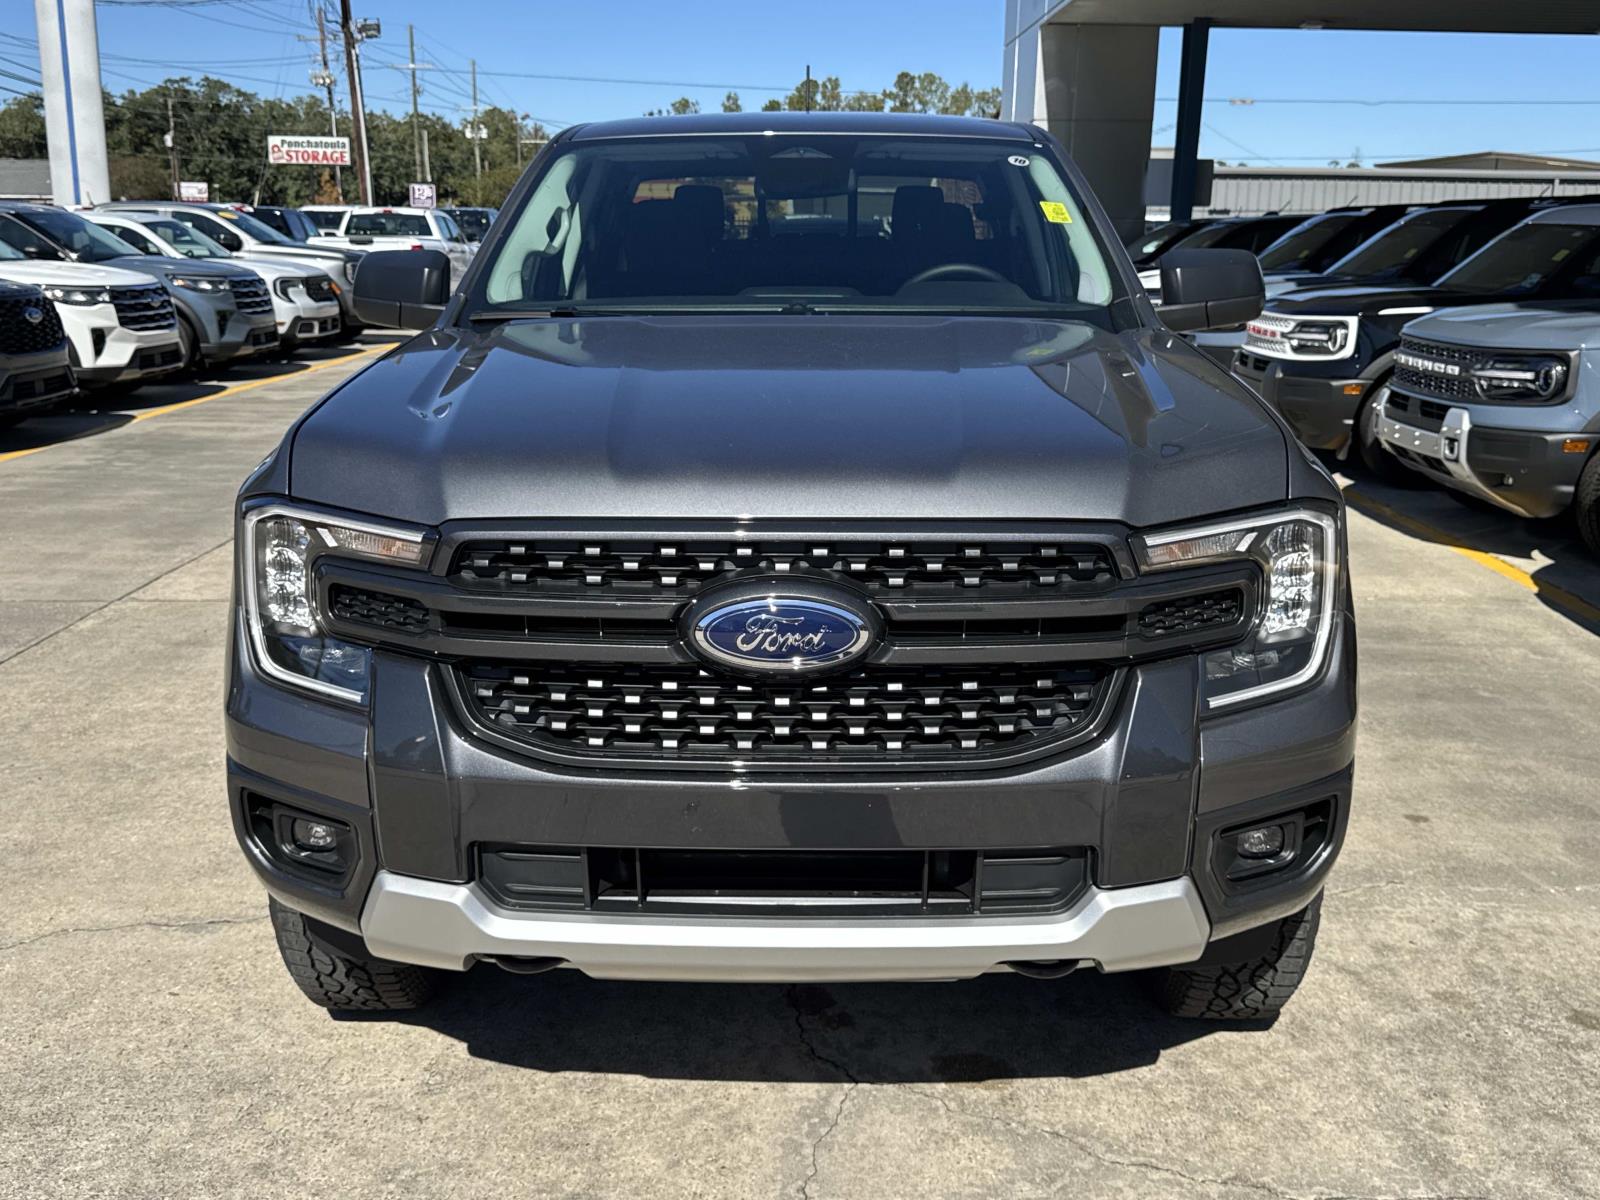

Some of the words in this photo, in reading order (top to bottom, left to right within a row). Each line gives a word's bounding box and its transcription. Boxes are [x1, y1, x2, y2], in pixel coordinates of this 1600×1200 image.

[281, 139, 346, 149] Ponchatoula
[285, 150, 347, 163] STORAGE
[737, 614, 828, 652] Ford
